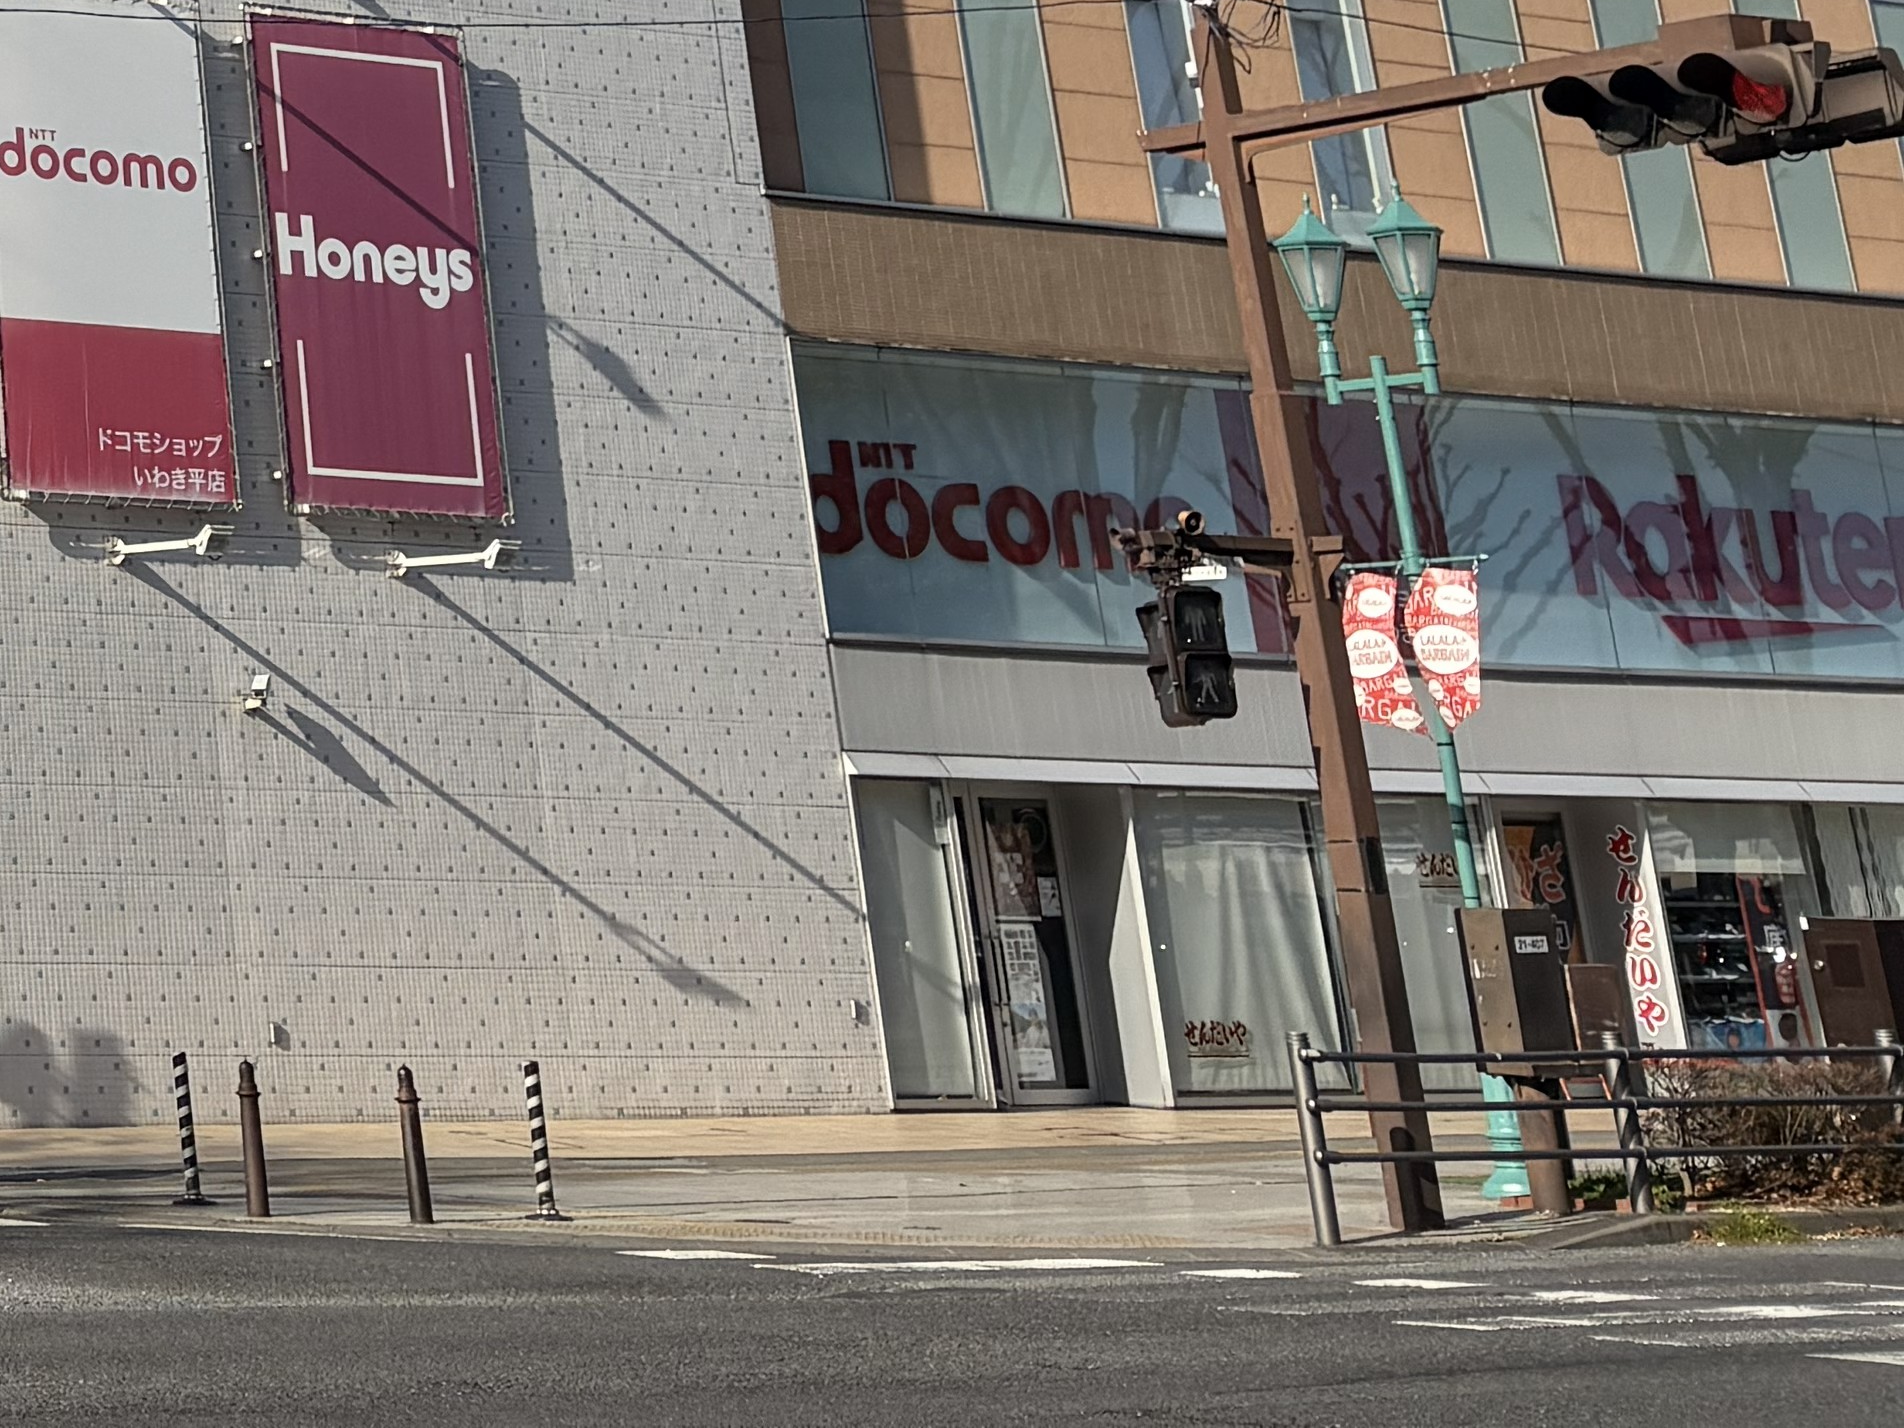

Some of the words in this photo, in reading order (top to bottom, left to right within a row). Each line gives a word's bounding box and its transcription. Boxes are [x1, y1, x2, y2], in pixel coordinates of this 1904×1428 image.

[29, 128, 58, 141] NTT
[277, 212, 476, 312] Honeys
[96, 427, 223, 460] ドコモショップ
[856, 441, 917, 470] NTT
[133, 465, 227, 495] いわき平店
[1606, 824, 1670, 1038] せんだいや
[1184, 1020, 1248, 1046] せんだいや
